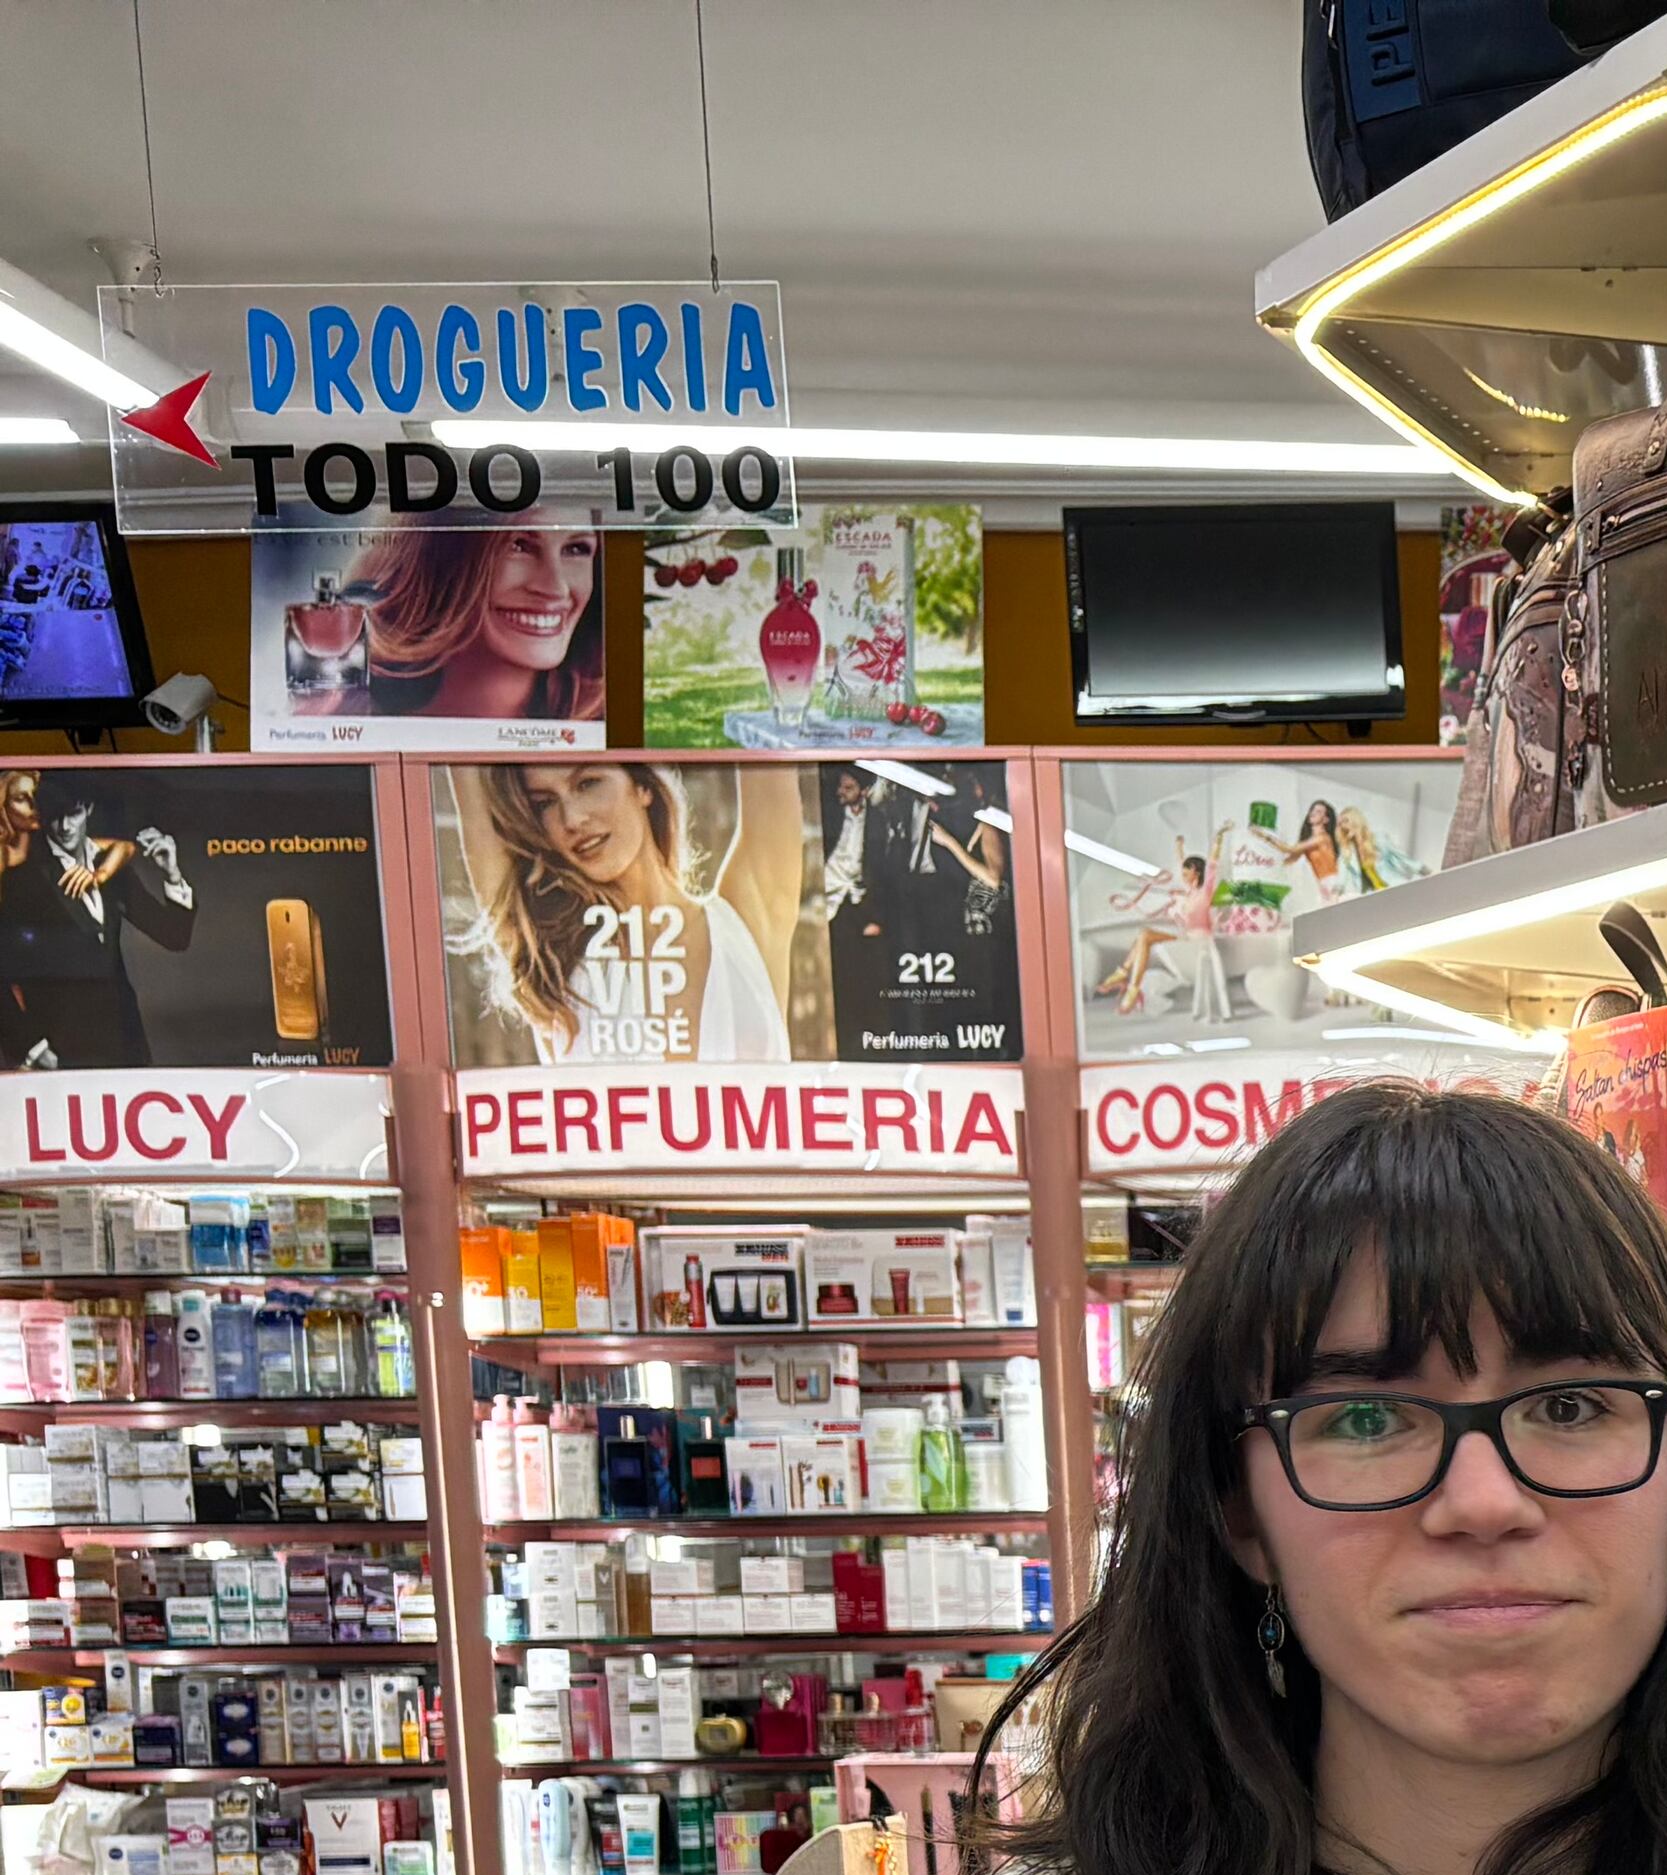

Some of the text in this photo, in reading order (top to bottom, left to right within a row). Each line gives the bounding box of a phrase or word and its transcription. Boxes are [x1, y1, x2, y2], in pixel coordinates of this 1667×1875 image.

[247, 302, 777, 415] DROGUERIA
[230, 441, 782, 515] TODO 100
[331, 726, 363, 741] LUCY
[208, 835, 368, 857] paco rabanne
[583, 904, 686, 958] 212
[586, 961, 686, 1015] VIP
[899, 953, 956, 983] 212
[590, 1008, 691, 1054] ROSÉ
[862, 1024, 1005, 1049] Perfumeria LUCY
[252, 1047, 360, 1066] Perfumeria LUCY
[26, 1090, 247, 1162] LUCY
[467, 1086, 1012, 1158] PERFUMERIA
